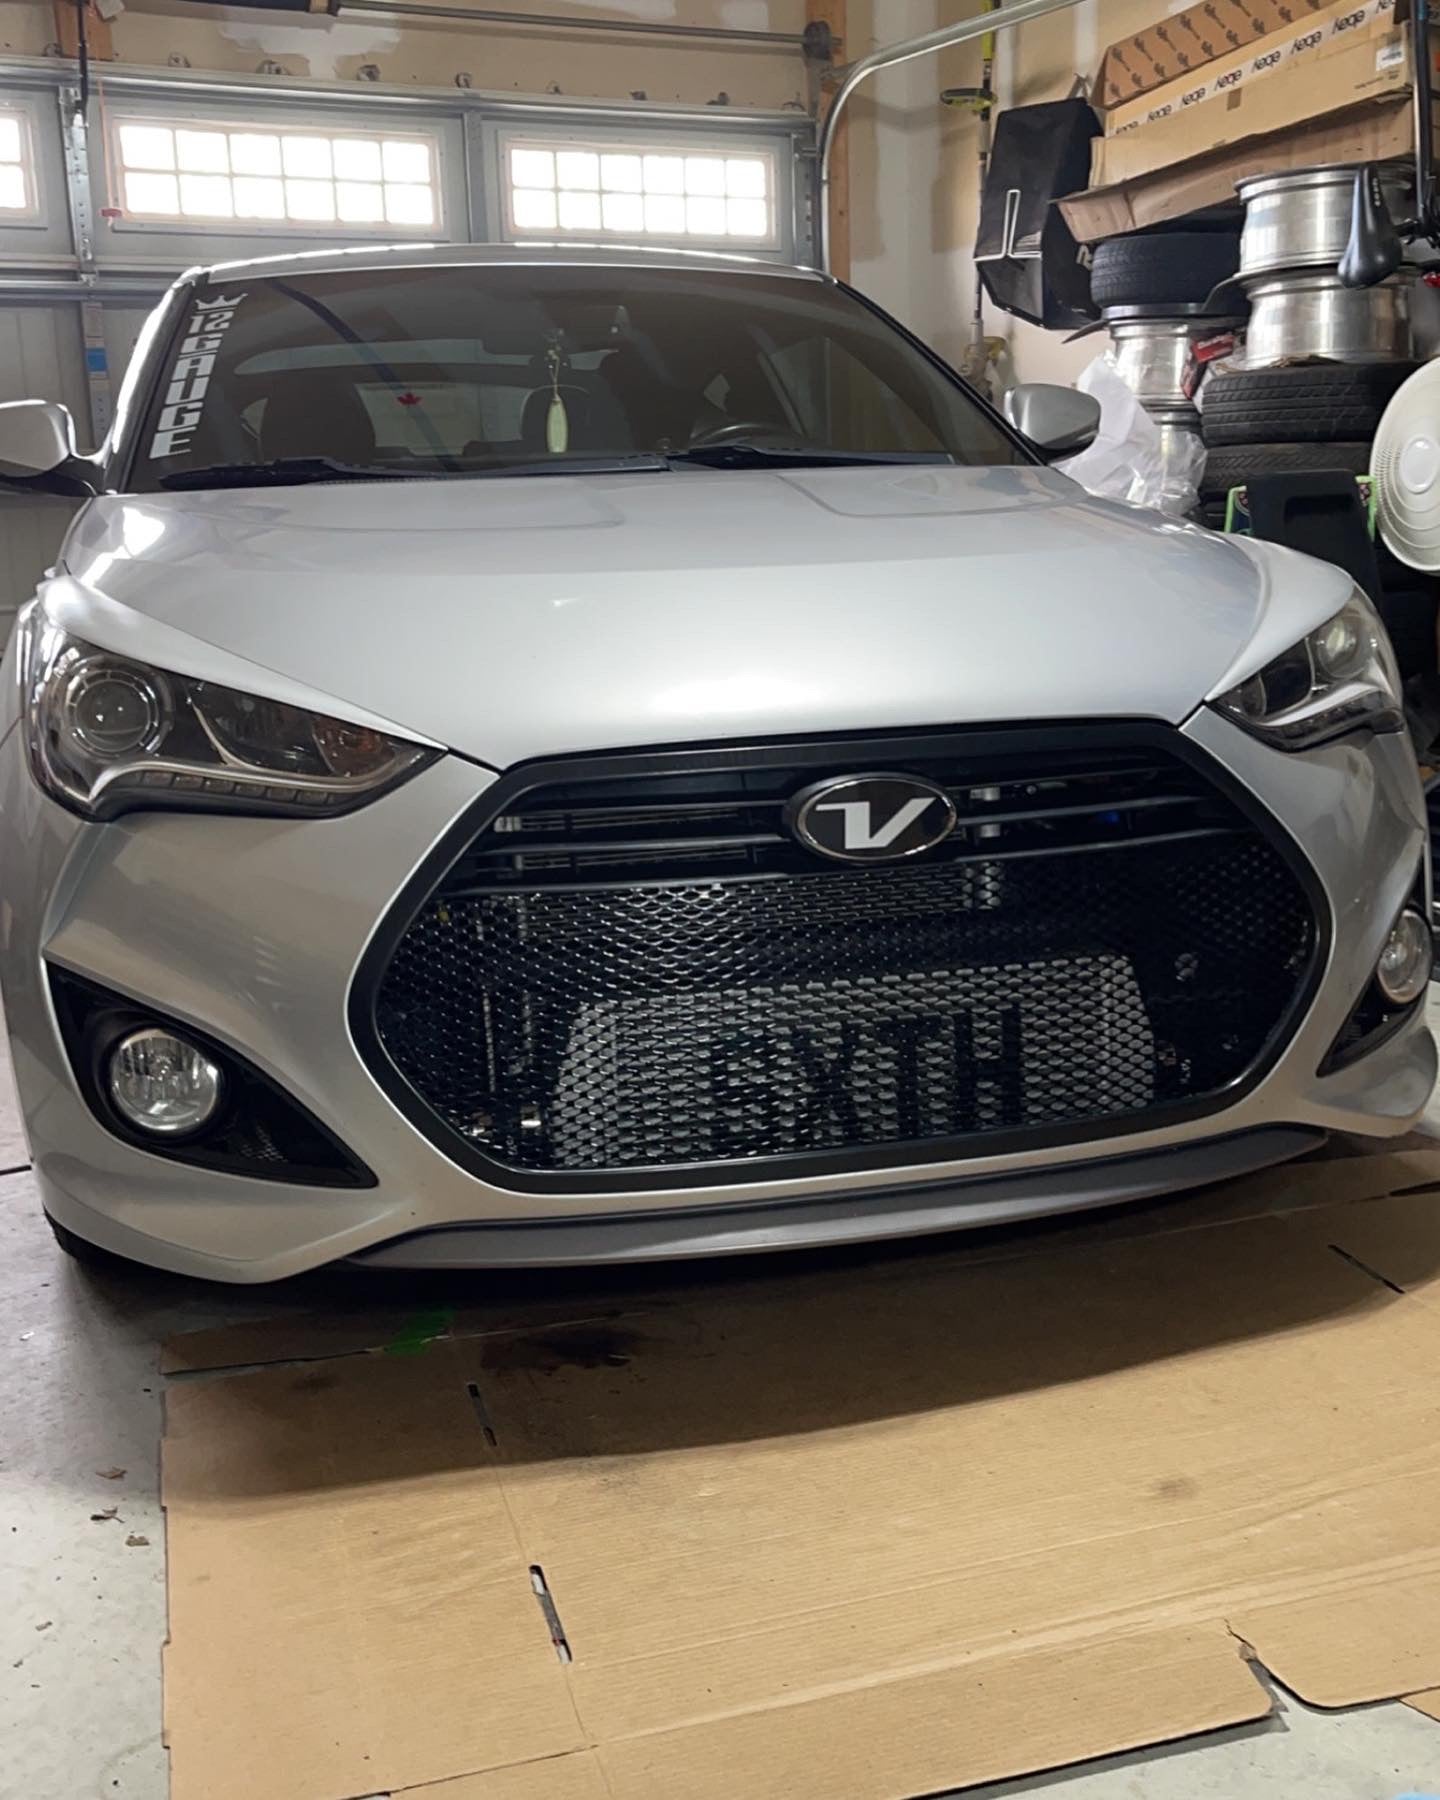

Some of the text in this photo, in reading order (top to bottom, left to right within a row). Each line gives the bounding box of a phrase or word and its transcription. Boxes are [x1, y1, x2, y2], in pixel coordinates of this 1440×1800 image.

[1331, 10, 1365, 34] ebay
[1290, 31, 1322, 55] ebay
[1251, 50, 1281, 73] ebay
[1214, 70, 1242, 91] ebay
[1180, 87, 1206, 108] ebay
[149, 311, 234, 459] 12 GAUGE
